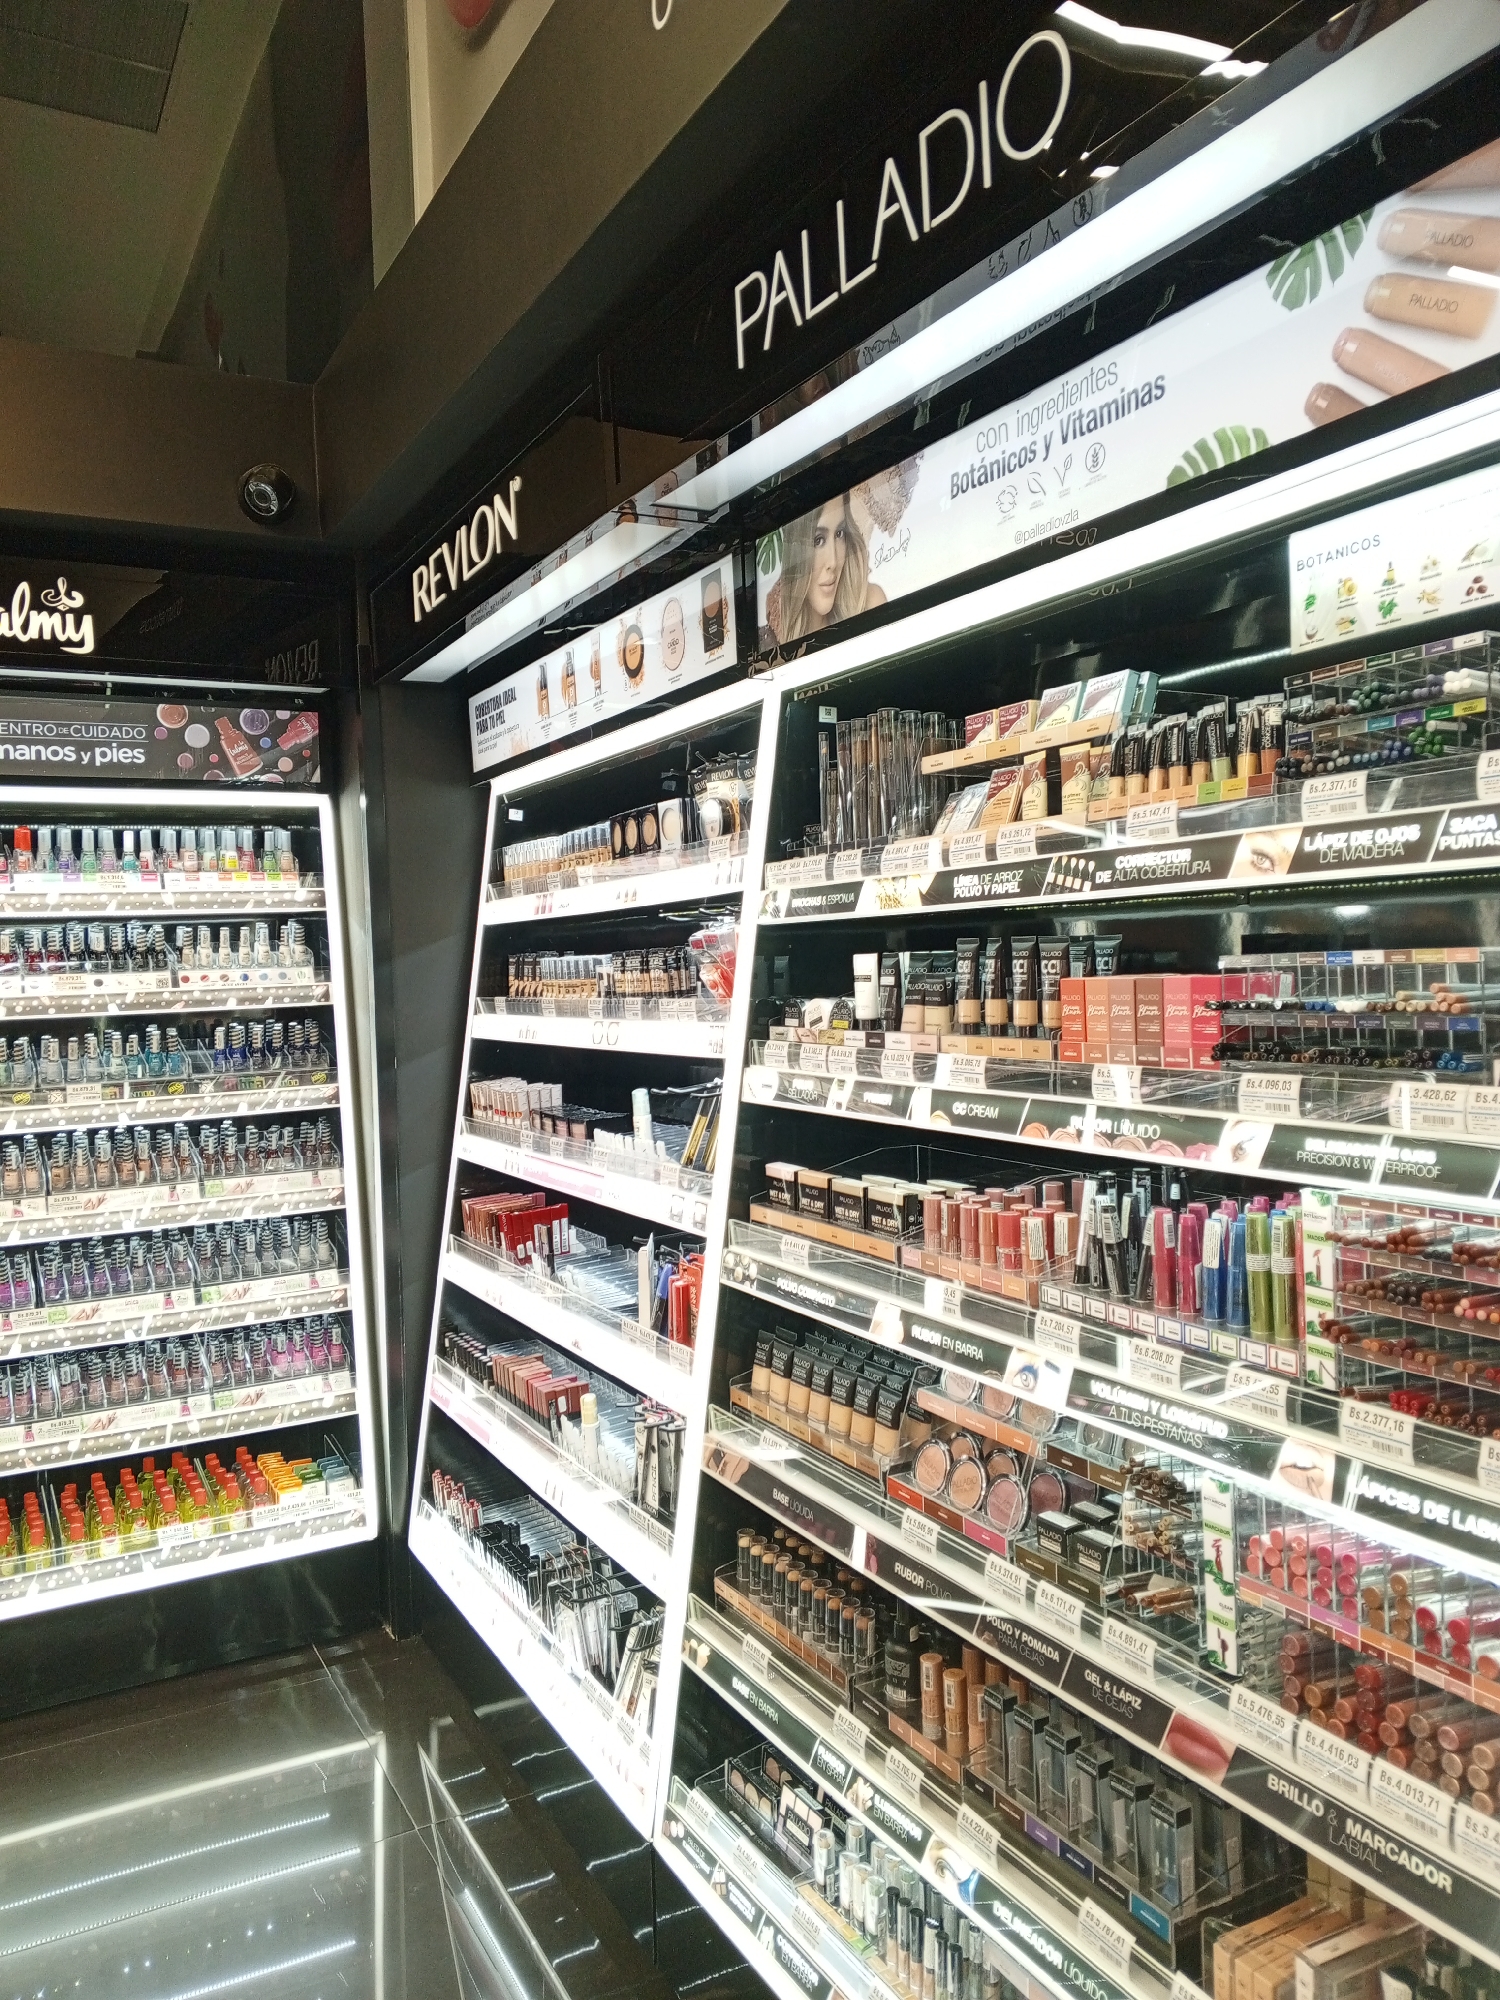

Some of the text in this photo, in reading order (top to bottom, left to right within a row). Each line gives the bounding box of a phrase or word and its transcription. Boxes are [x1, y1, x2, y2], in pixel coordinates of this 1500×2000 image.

[733, 30, 1073, 369] PALLADIO
[1426, 229, 1474, 248] PALLADIO
[1409, 293, 1459, 314] PALLADIO
[976, 361, 1118, 453] con ingredientes
[951, 374, 1166, 500] Botánicos y Vitaminas
[1014, 507, 1080, 545] @palladiovzla
[475, 687, 517, 719] COBERTURA IDEAL
[70, 725, 146, 739] CUIDADO
[476, 710, 505, 736] PARA TU PIEL
[80, 751, 91, 764] y
[95, 743, 146, 766] pies
[1309, 779, 1358, 794] Bs.2.377,16
[1131, 806, 1171, 821] Bs.5.147,41
[1449, 813, 1498, 834] SACA
[1303, 824, 1421, 852] LÁPIZ DE OJOS
[1115, 847, 1192, 870] CORRECTOR
[1319, 842, 1405, 864] DE MADERA
[980, 873, 992, 884] DE
[993, 869, 1023, 882] ARROZ
[1095, 859, 1212, 884] DE ALTA COBERTURA
[953, 880, 1021, 899] POLVO Y PAPEL
[1138, 993, 1159, 1001] PALLADIO
[1166, 993, 1188, 1001] PALLADIO
[1193, 993, 1217, 1001] PALLADIO
[788, 1087, 818, 1101] SELLADOR
[1246, 1078, 1292, 1092] Bs.4.096,03
[967, 1105, 1000, 1120] CREAM
[1114, 1118, 1160, 1140] LÍQUIDO
[1297, 1151, 1351, 1167] PRECISION
[1353, 1158, 1360, 1169] &
[814, 1201, 824, 1209] DRY
[849, 1210, 859, 1219] DRY
[871, 1215, 881, 1223] WET
[887, 1219, 898, 1227] DRY
[1307, 1297, 1332, 1309] PRECISION
[911, 1324, 984, 1363] RUBOR EN BARRA
[1109, 1405, 1204, 1449] A TUS PESTAÑAS
[1150, 1399, 1160, 1416] Y
[1161, 1403, 1229, 1440] LONGITUD
[1350, 1406, 1405, 1433] Bs.2.377,16
[773, 1488, 790, 1507] BASE
[1423, 1500, 1451, 1526] DE
[1038, 1526, 1063, 1542] PALLADIO
[1077, 1543, 1102, 1561] PALLADIO
[894, 1562, 924, 1589] RUBOR
[986, 1614, 1059, 1663] POLVO Y POMADA
[999, 1632, 1045, 1667] PARA CEJAS
[1084, 1669, 1142, 1711] GEL & LÁPIZ
[750, 1690, 758, 1705] EN
[758, 1697, 779, 1725] BARRA
[1092, 1688, 1134, 1719] DE CEJAS
[1237, 1693, 1285, 1729] Bs.5.476,55
[817, 1756, 847, 1787] EN SPRAY
[1380, 1770, 1440, 1813] Bs.4.013,71
[787, 1811, 811, 1838] PALLADIO
[874, 1803, 908, 1843] EN BARRA
[1267, 1773, 1453, 1895] BRILLO & MARCADOR
[1329, 1826, 1383, 1873] LABIAL
[993, 1900, 1063, 1970] DELINEADOR
[781, 1950, 813, 1991] EN BARRA
